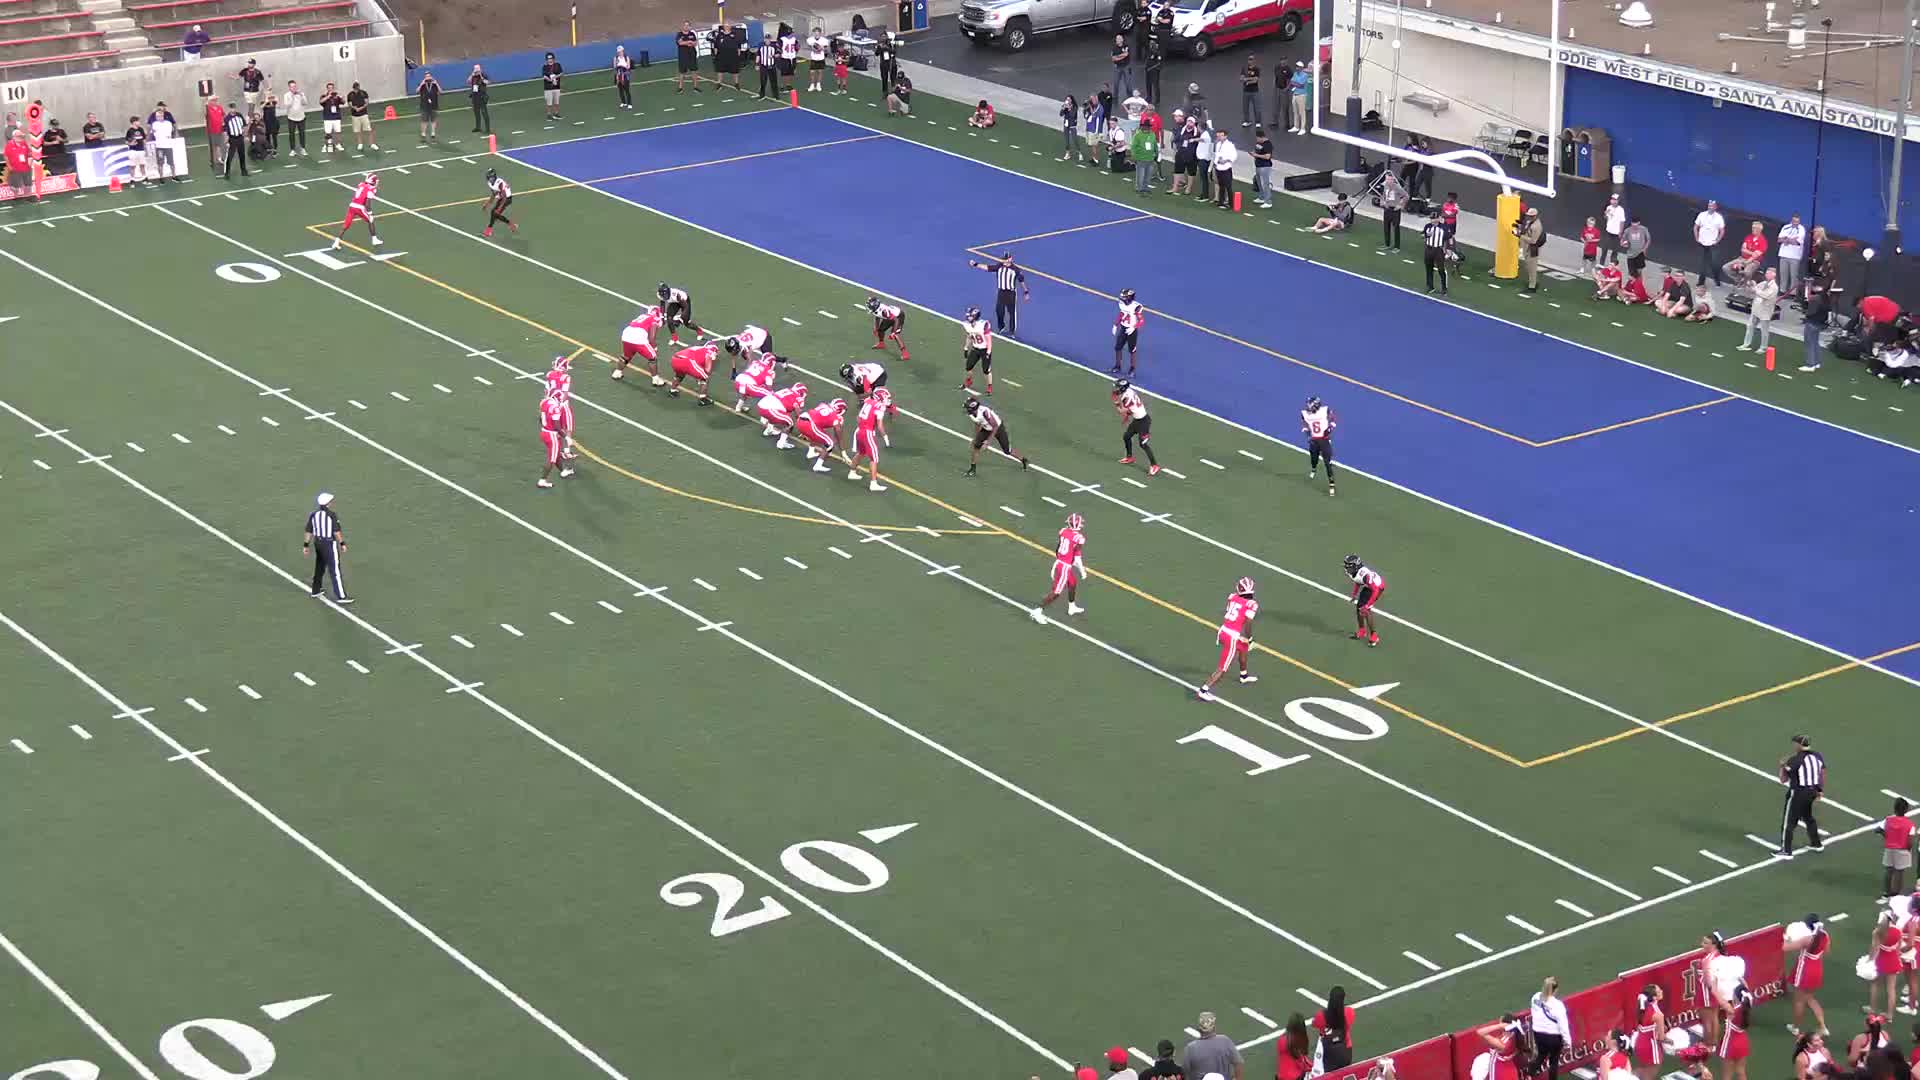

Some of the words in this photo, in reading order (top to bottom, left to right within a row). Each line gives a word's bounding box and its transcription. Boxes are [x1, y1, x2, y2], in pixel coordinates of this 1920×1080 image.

[1347, 24, 1383, 40] VITORS
[8, 86, 25, 100] 10
[1604, 60, 1652, 80] WEST
[1657, 73, 1705, 92] FIELD
[1718, 86, 1776, 108] SANTA
[1781, 99, 1819, 118] ANA
[215, 246, 368, 284] 10
[1176, 697, 1390, 776] 10
[660, 840, 891, 937] 20
